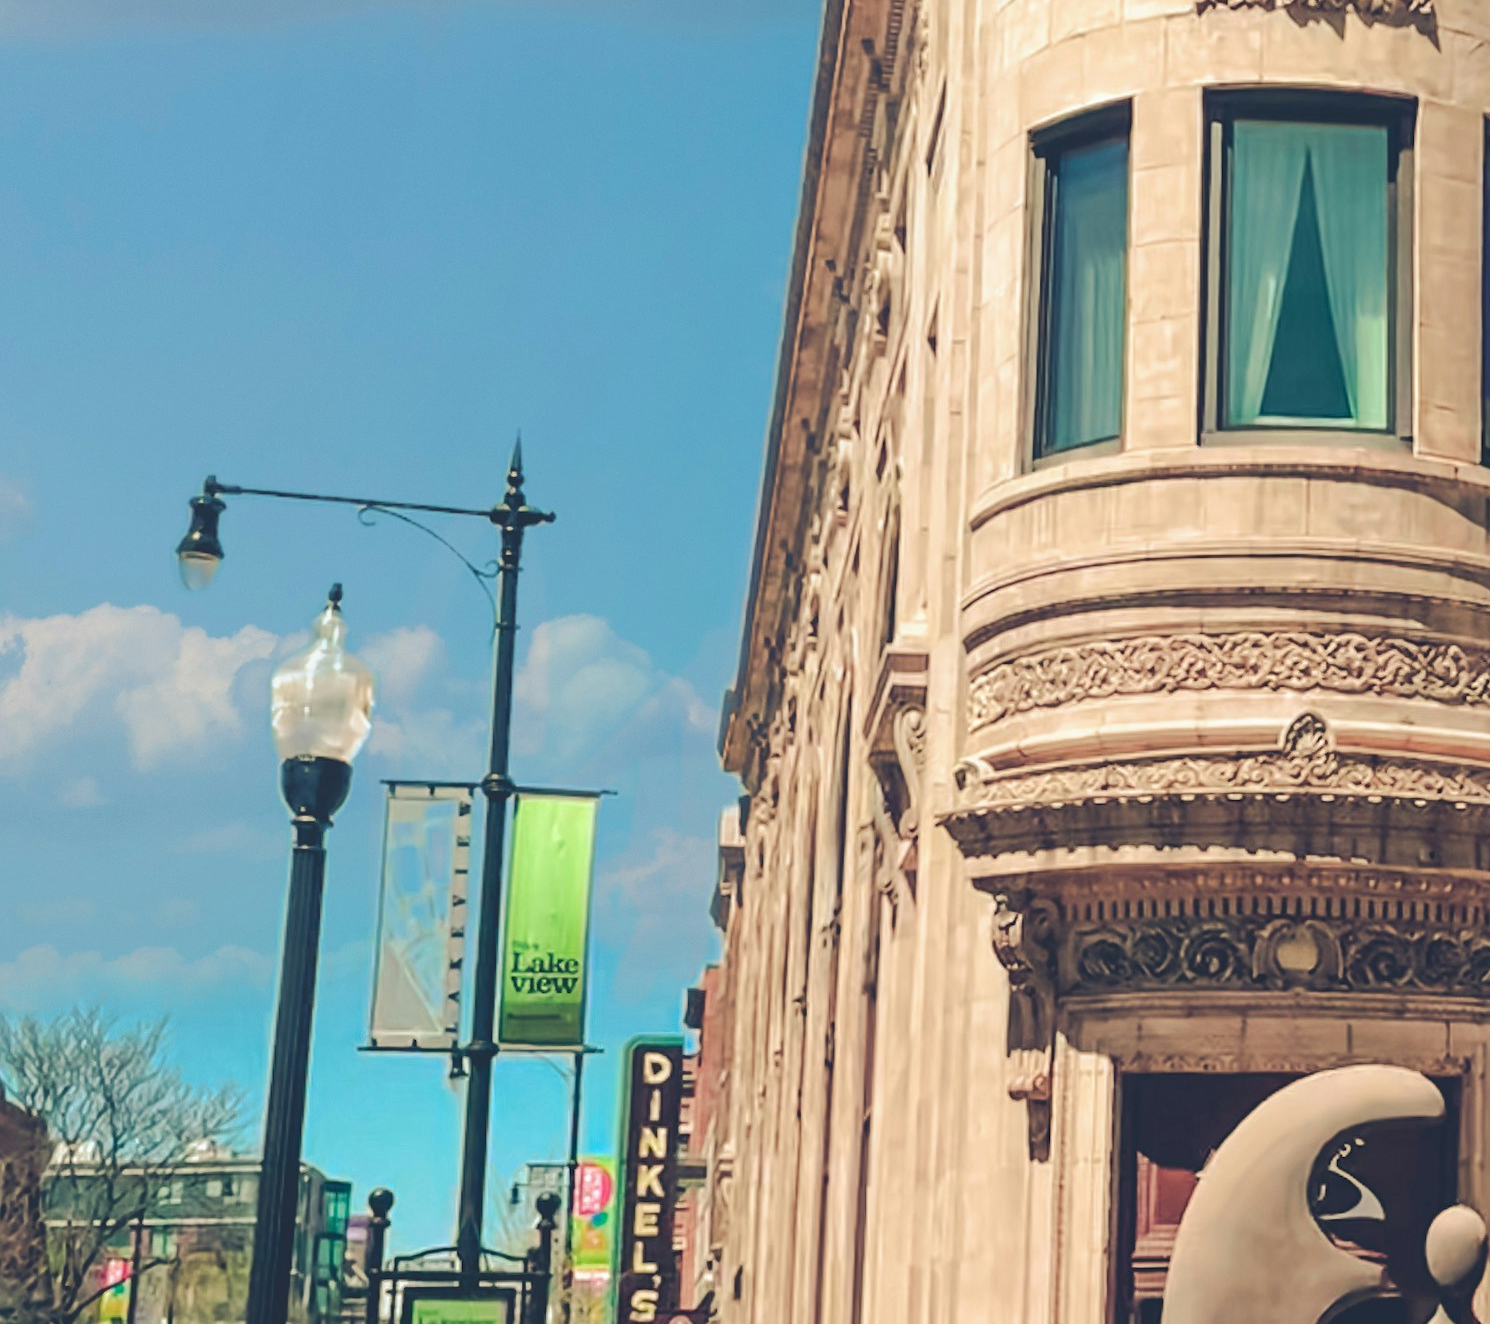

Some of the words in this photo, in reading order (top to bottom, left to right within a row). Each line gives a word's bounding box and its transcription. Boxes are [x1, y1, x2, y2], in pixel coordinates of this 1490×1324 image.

[511, 952, 579, 974] Lake
[511, 976, 579, 993] view
[629, 1051, 673, 1323] DINKEL'S
